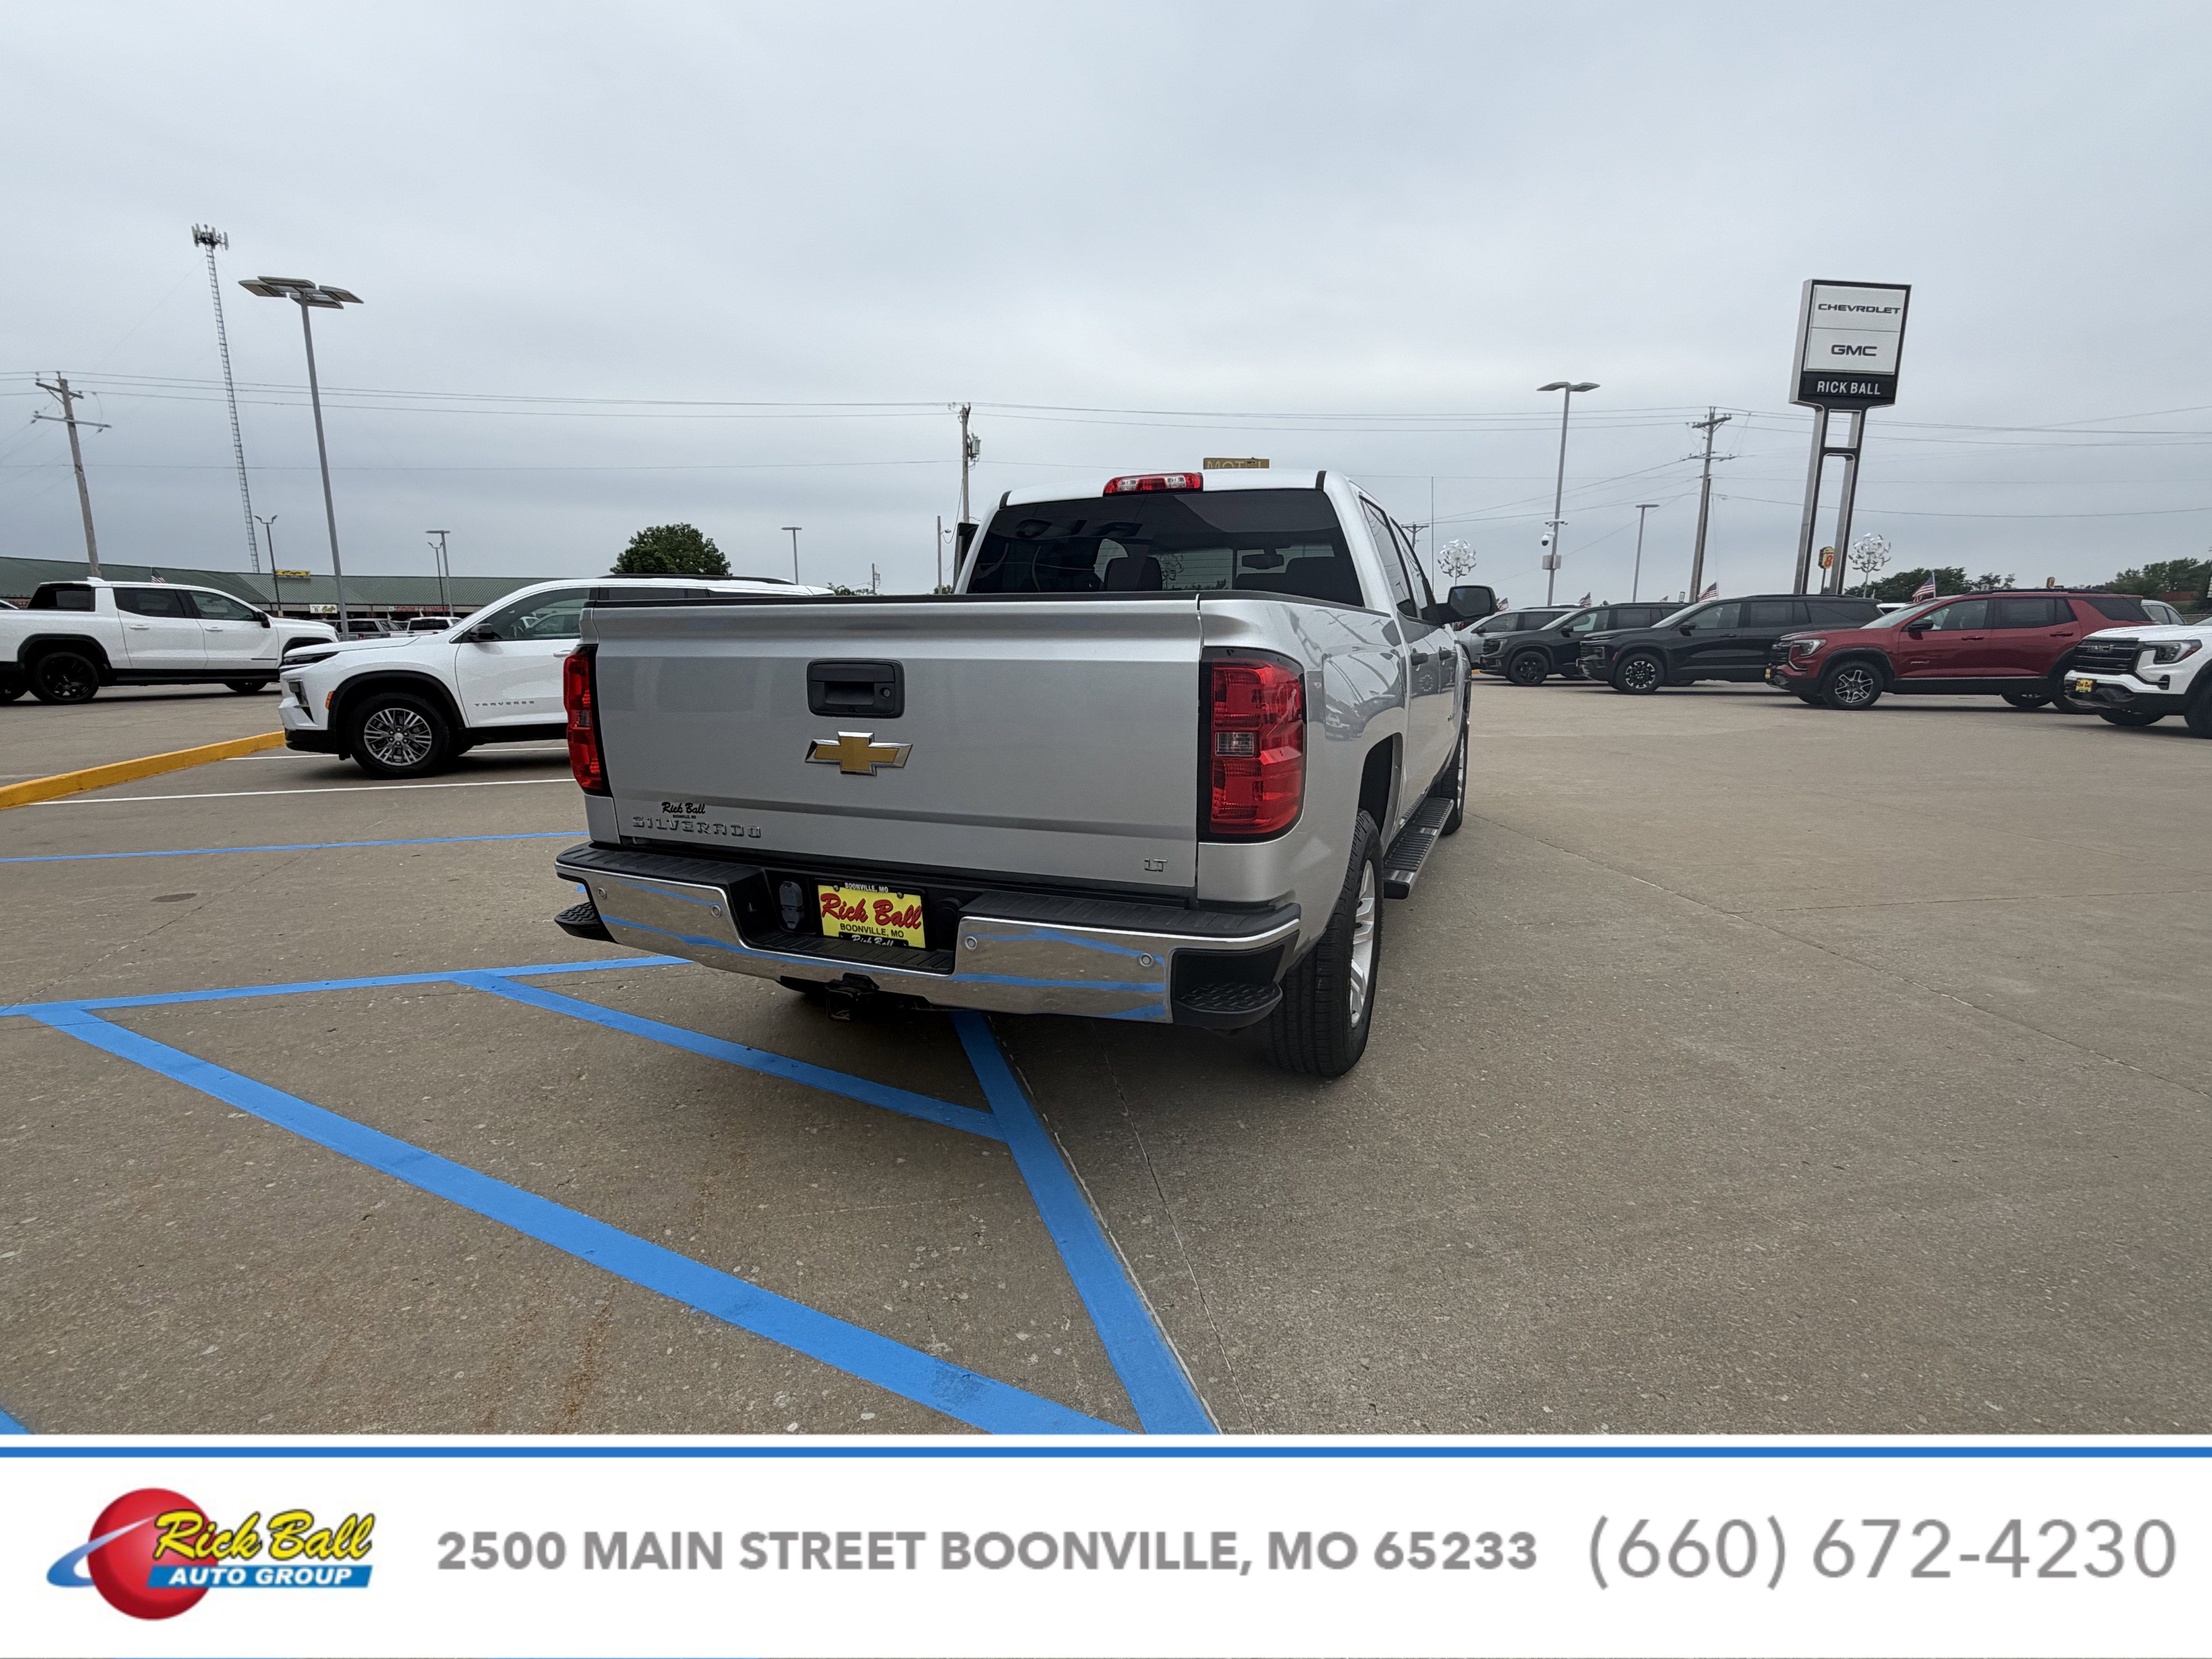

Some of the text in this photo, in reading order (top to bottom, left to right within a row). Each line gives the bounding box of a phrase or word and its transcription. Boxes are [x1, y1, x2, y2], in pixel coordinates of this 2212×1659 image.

[1818, 304, 1901, 314] CHEVROLET
[1831, 344, 1877, 357] GMC
[1817, 381, 1881, 395] RICK BALL
[1824, 555, 1833, 567] 8
[661, 802, 706, 814] Rick Ball
[633, 816, 761, 838] SILVERADO
[1144, 858, 1167, 872] LT
[845, 882, 877, 892] BOONVILLE,
[821, 893, 922, 929] Rick Ball
[840, 923, 890, 937] BOONVILLE,
